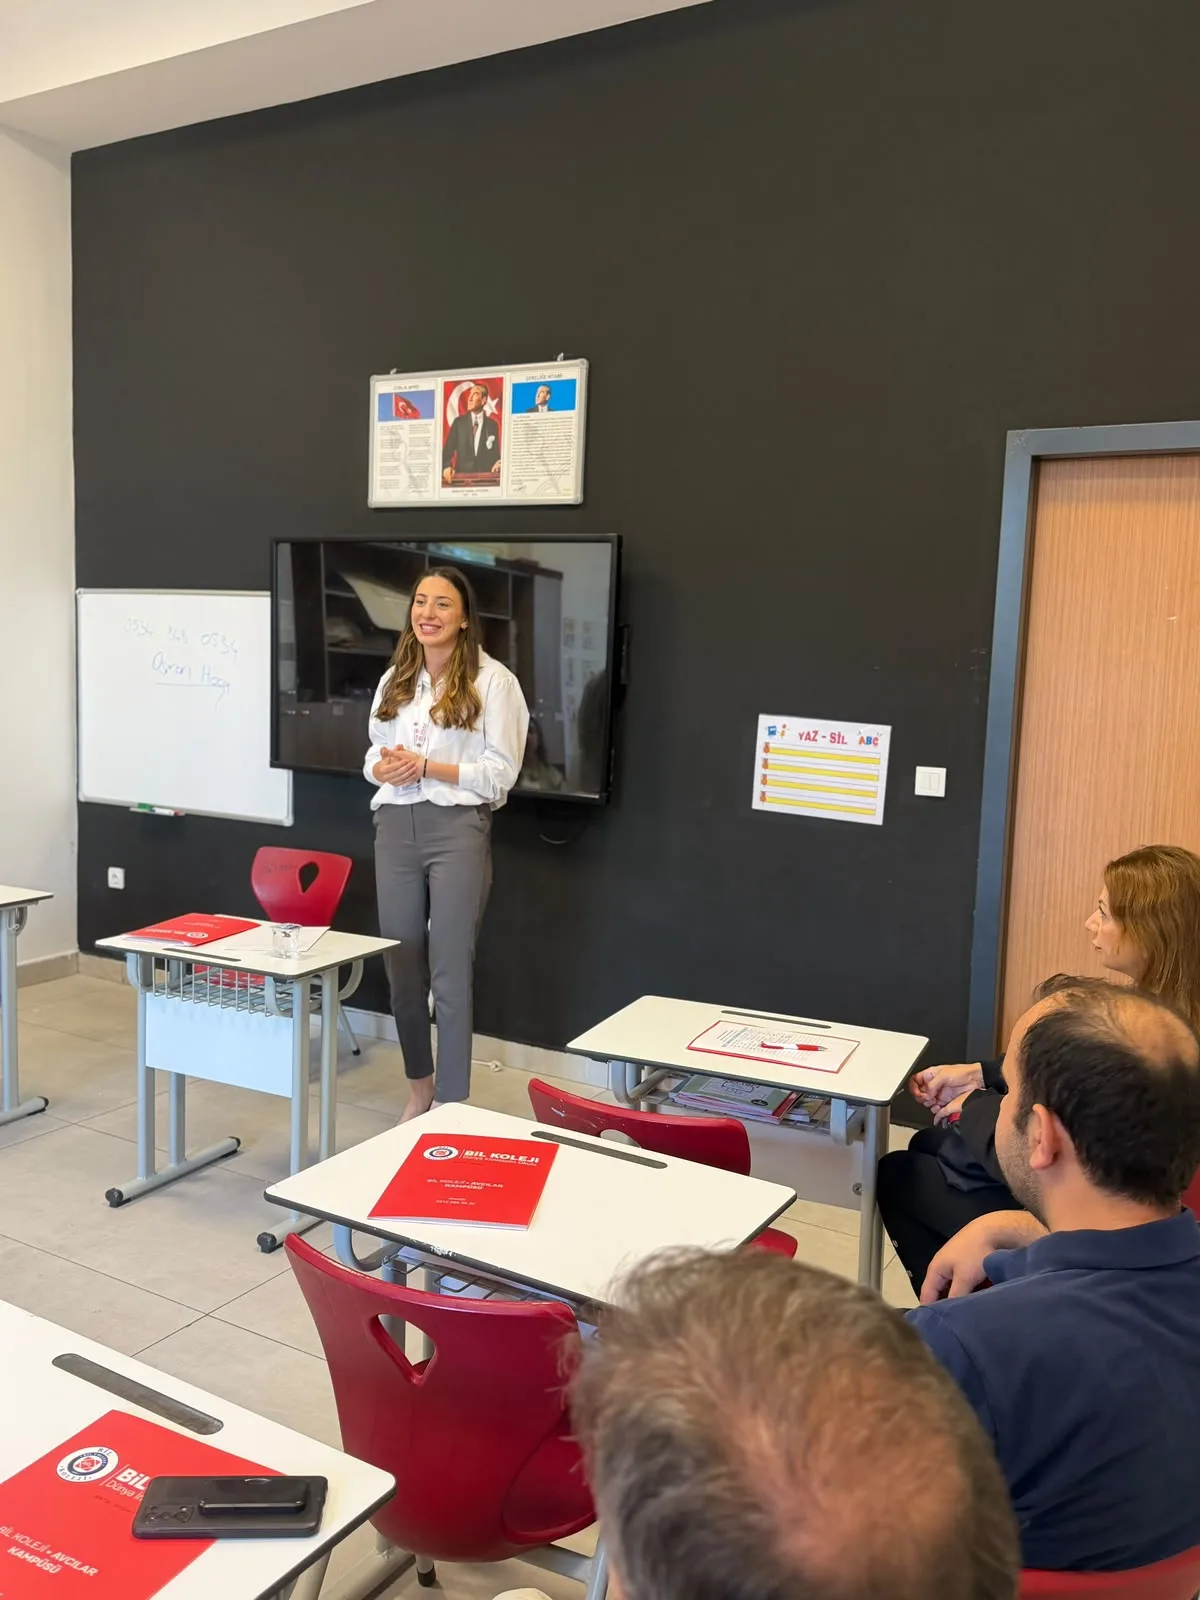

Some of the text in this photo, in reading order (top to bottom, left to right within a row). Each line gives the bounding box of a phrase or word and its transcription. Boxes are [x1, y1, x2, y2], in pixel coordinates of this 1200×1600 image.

[798, 730, 819, 744] YAZ
[829, 731, 848, 745] SİL
[858, 735, 879, 747] ABC
[105, 1480, 135, 1498] Dünya
[7, 1545, 62, 1574] KAMPÜSÜ
[50, 1551, 99, 1576] AVCILAR
